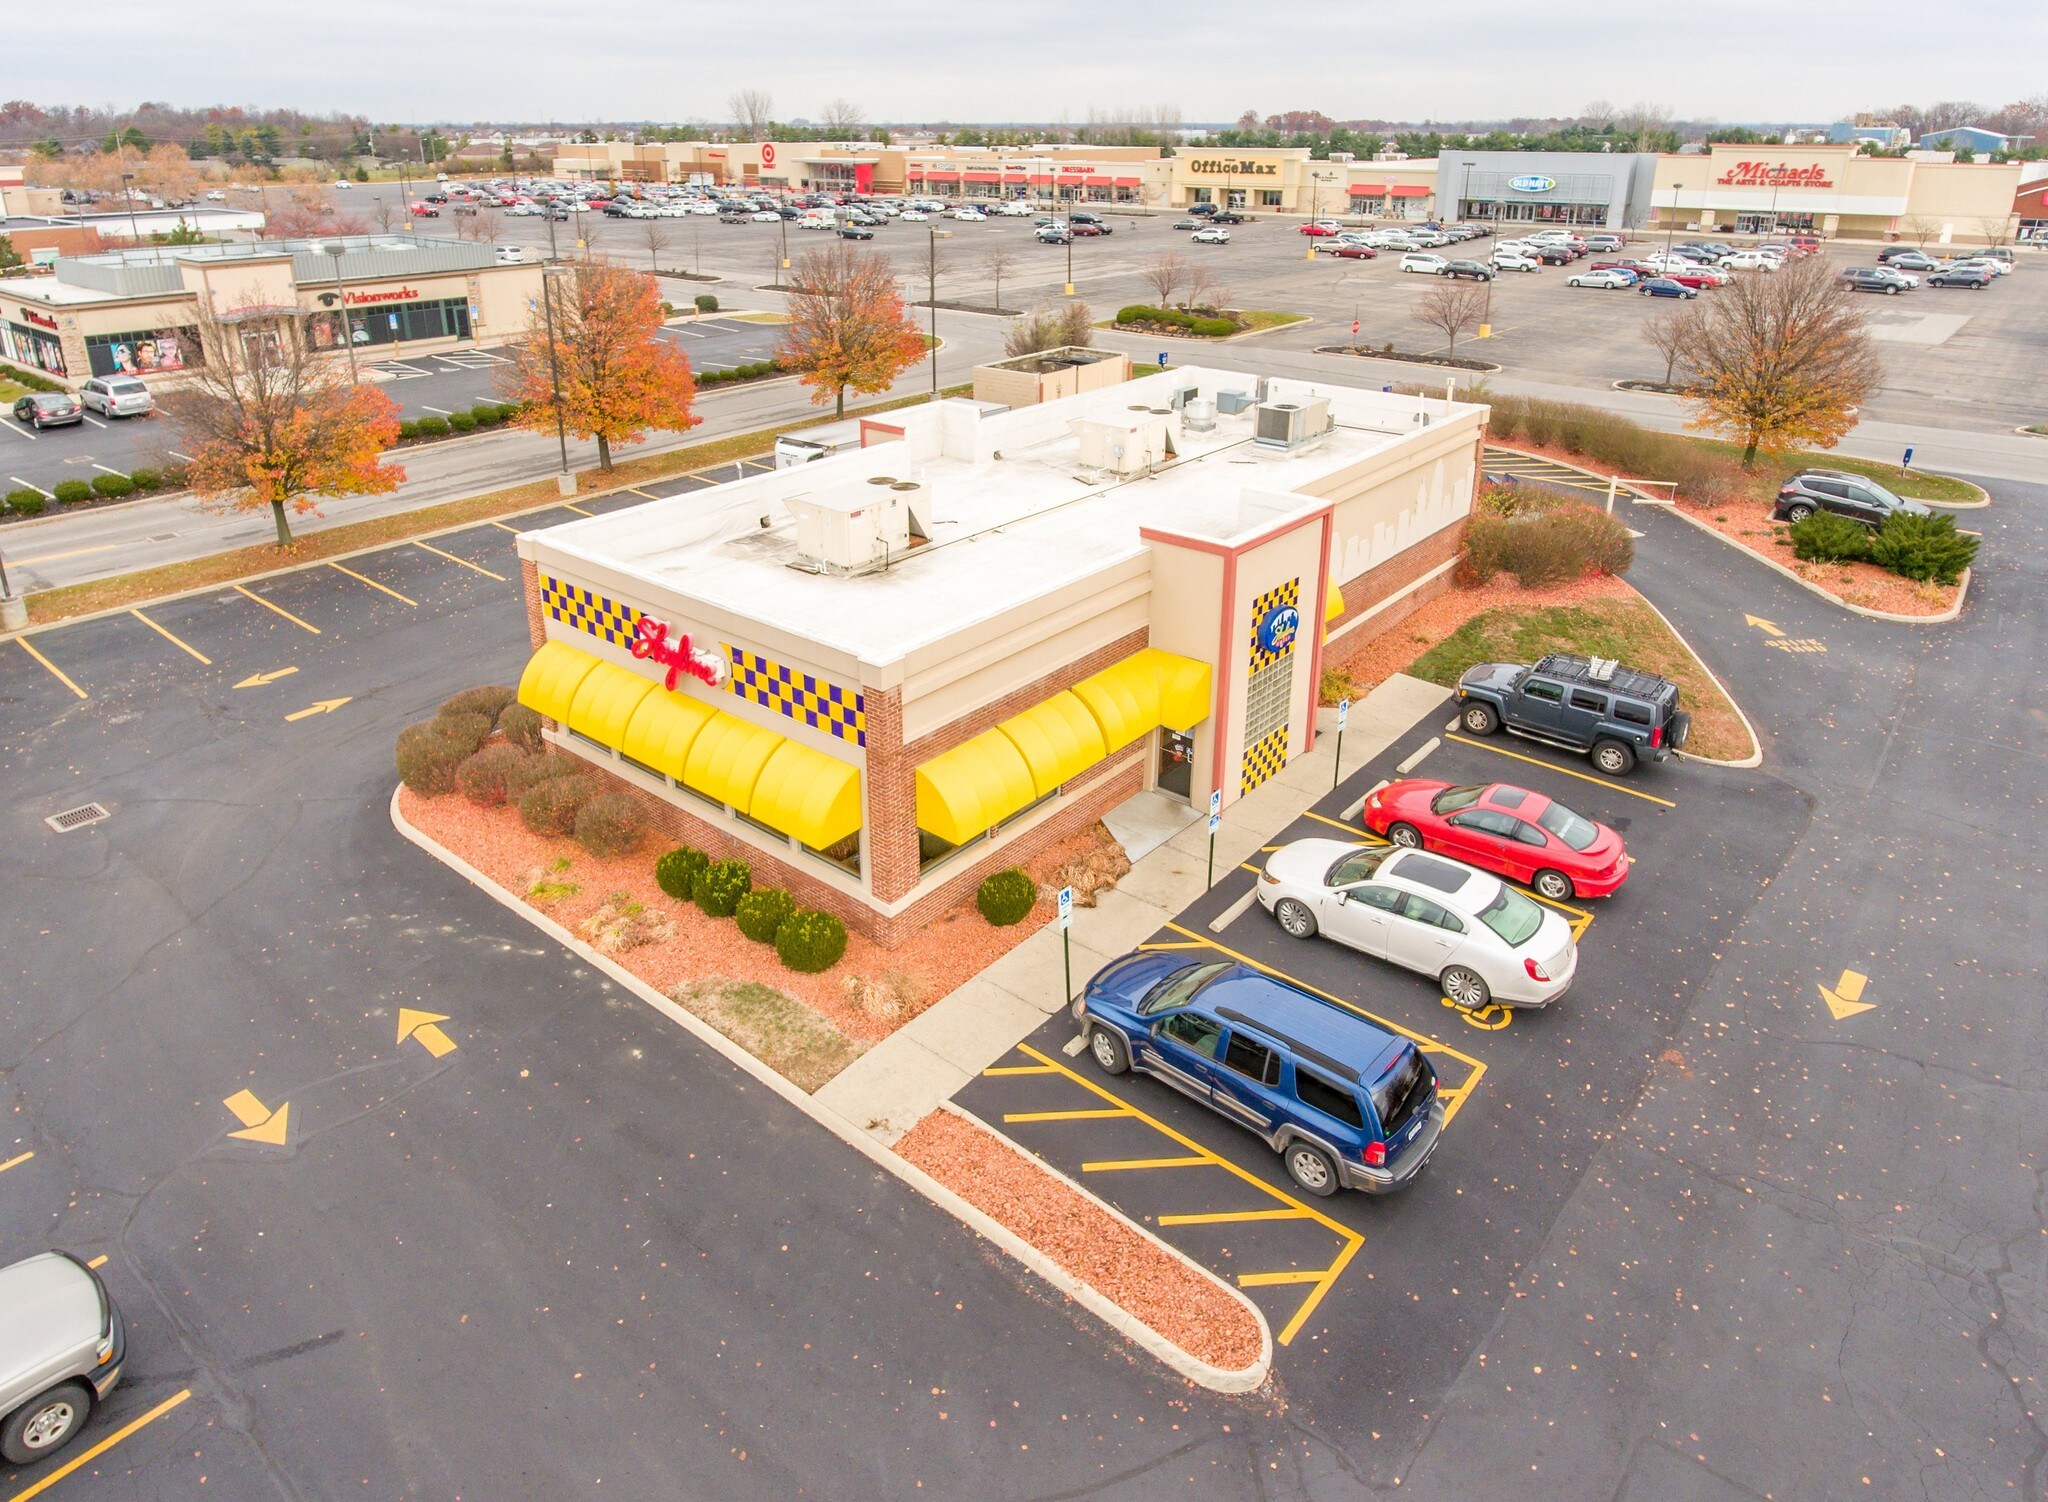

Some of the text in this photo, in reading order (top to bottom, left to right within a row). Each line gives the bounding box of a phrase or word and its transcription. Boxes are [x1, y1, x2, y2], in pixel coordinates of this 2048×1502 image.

[1191, 160, 1277, 174] OfficeMax
[1727, 162, 1825, 180] Michaels
[1513, 179, 1549, 187] OLD NAVY
[342, 286, 419, 305] Visionworks
